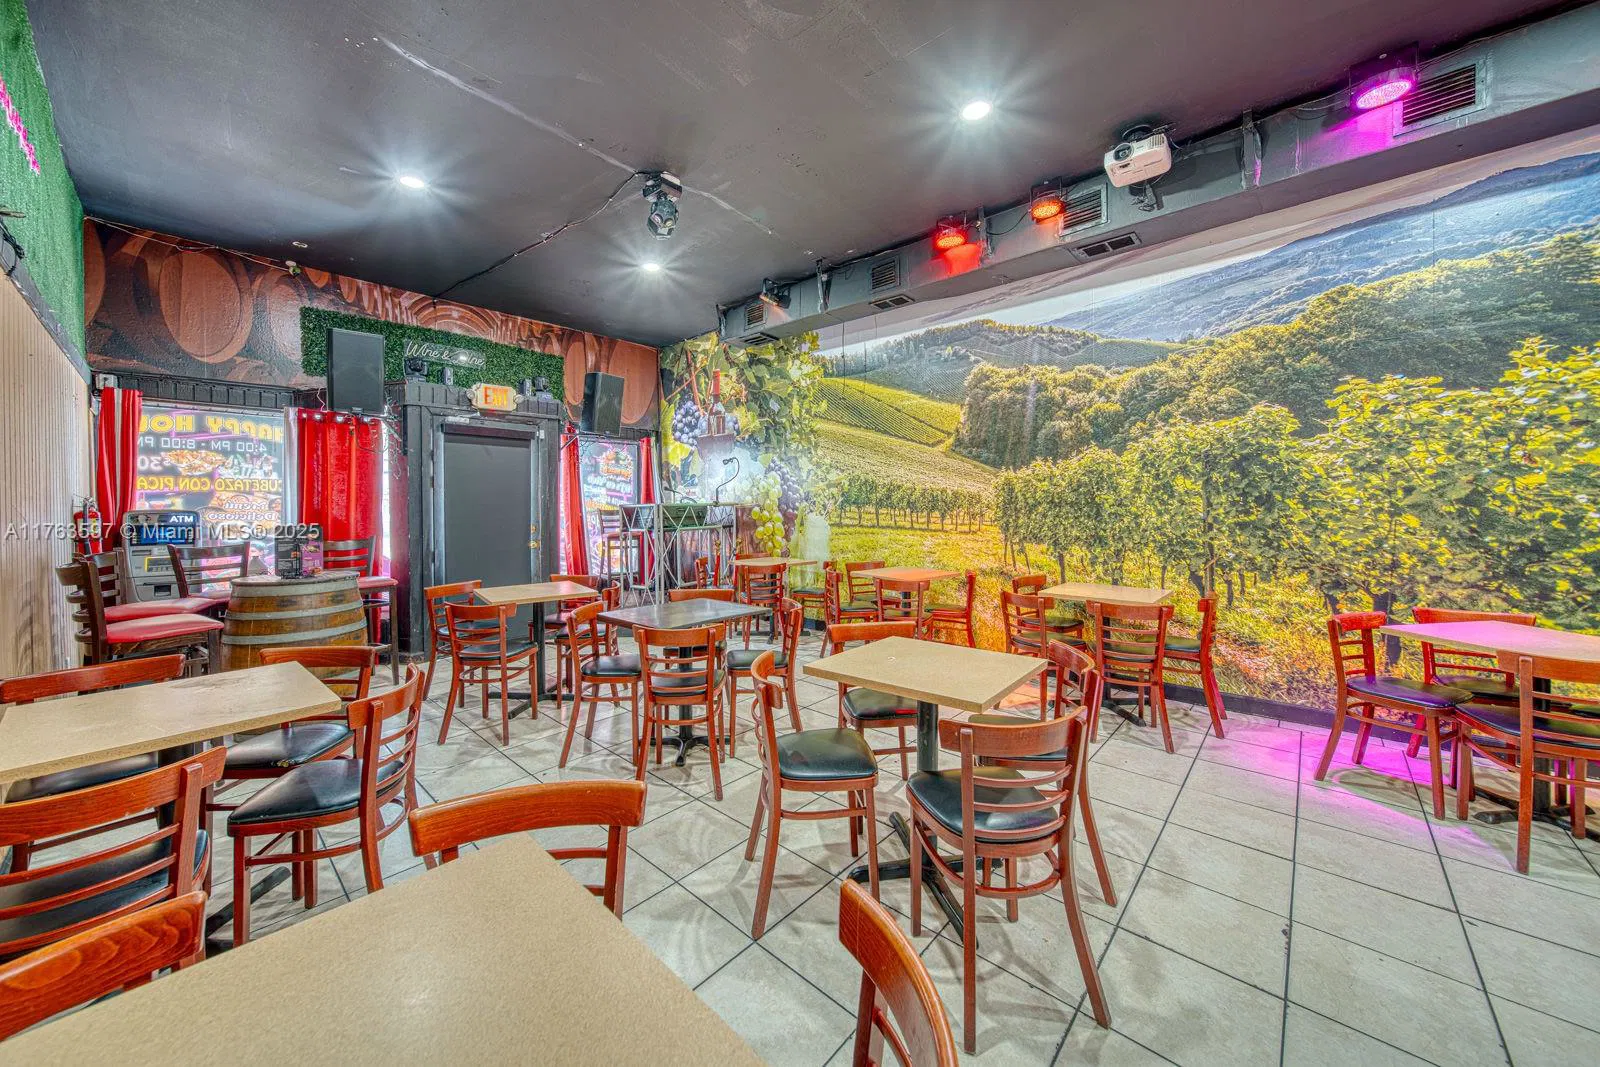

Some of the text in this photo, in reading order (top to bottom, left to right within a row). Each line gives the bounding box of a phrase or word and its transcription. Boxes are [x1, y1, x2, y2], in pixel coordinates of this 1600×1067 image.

[441, 350, 451, 360] &
[483, 386, 509, 406] EXIT
[169, 515, 194, 523] ATM
